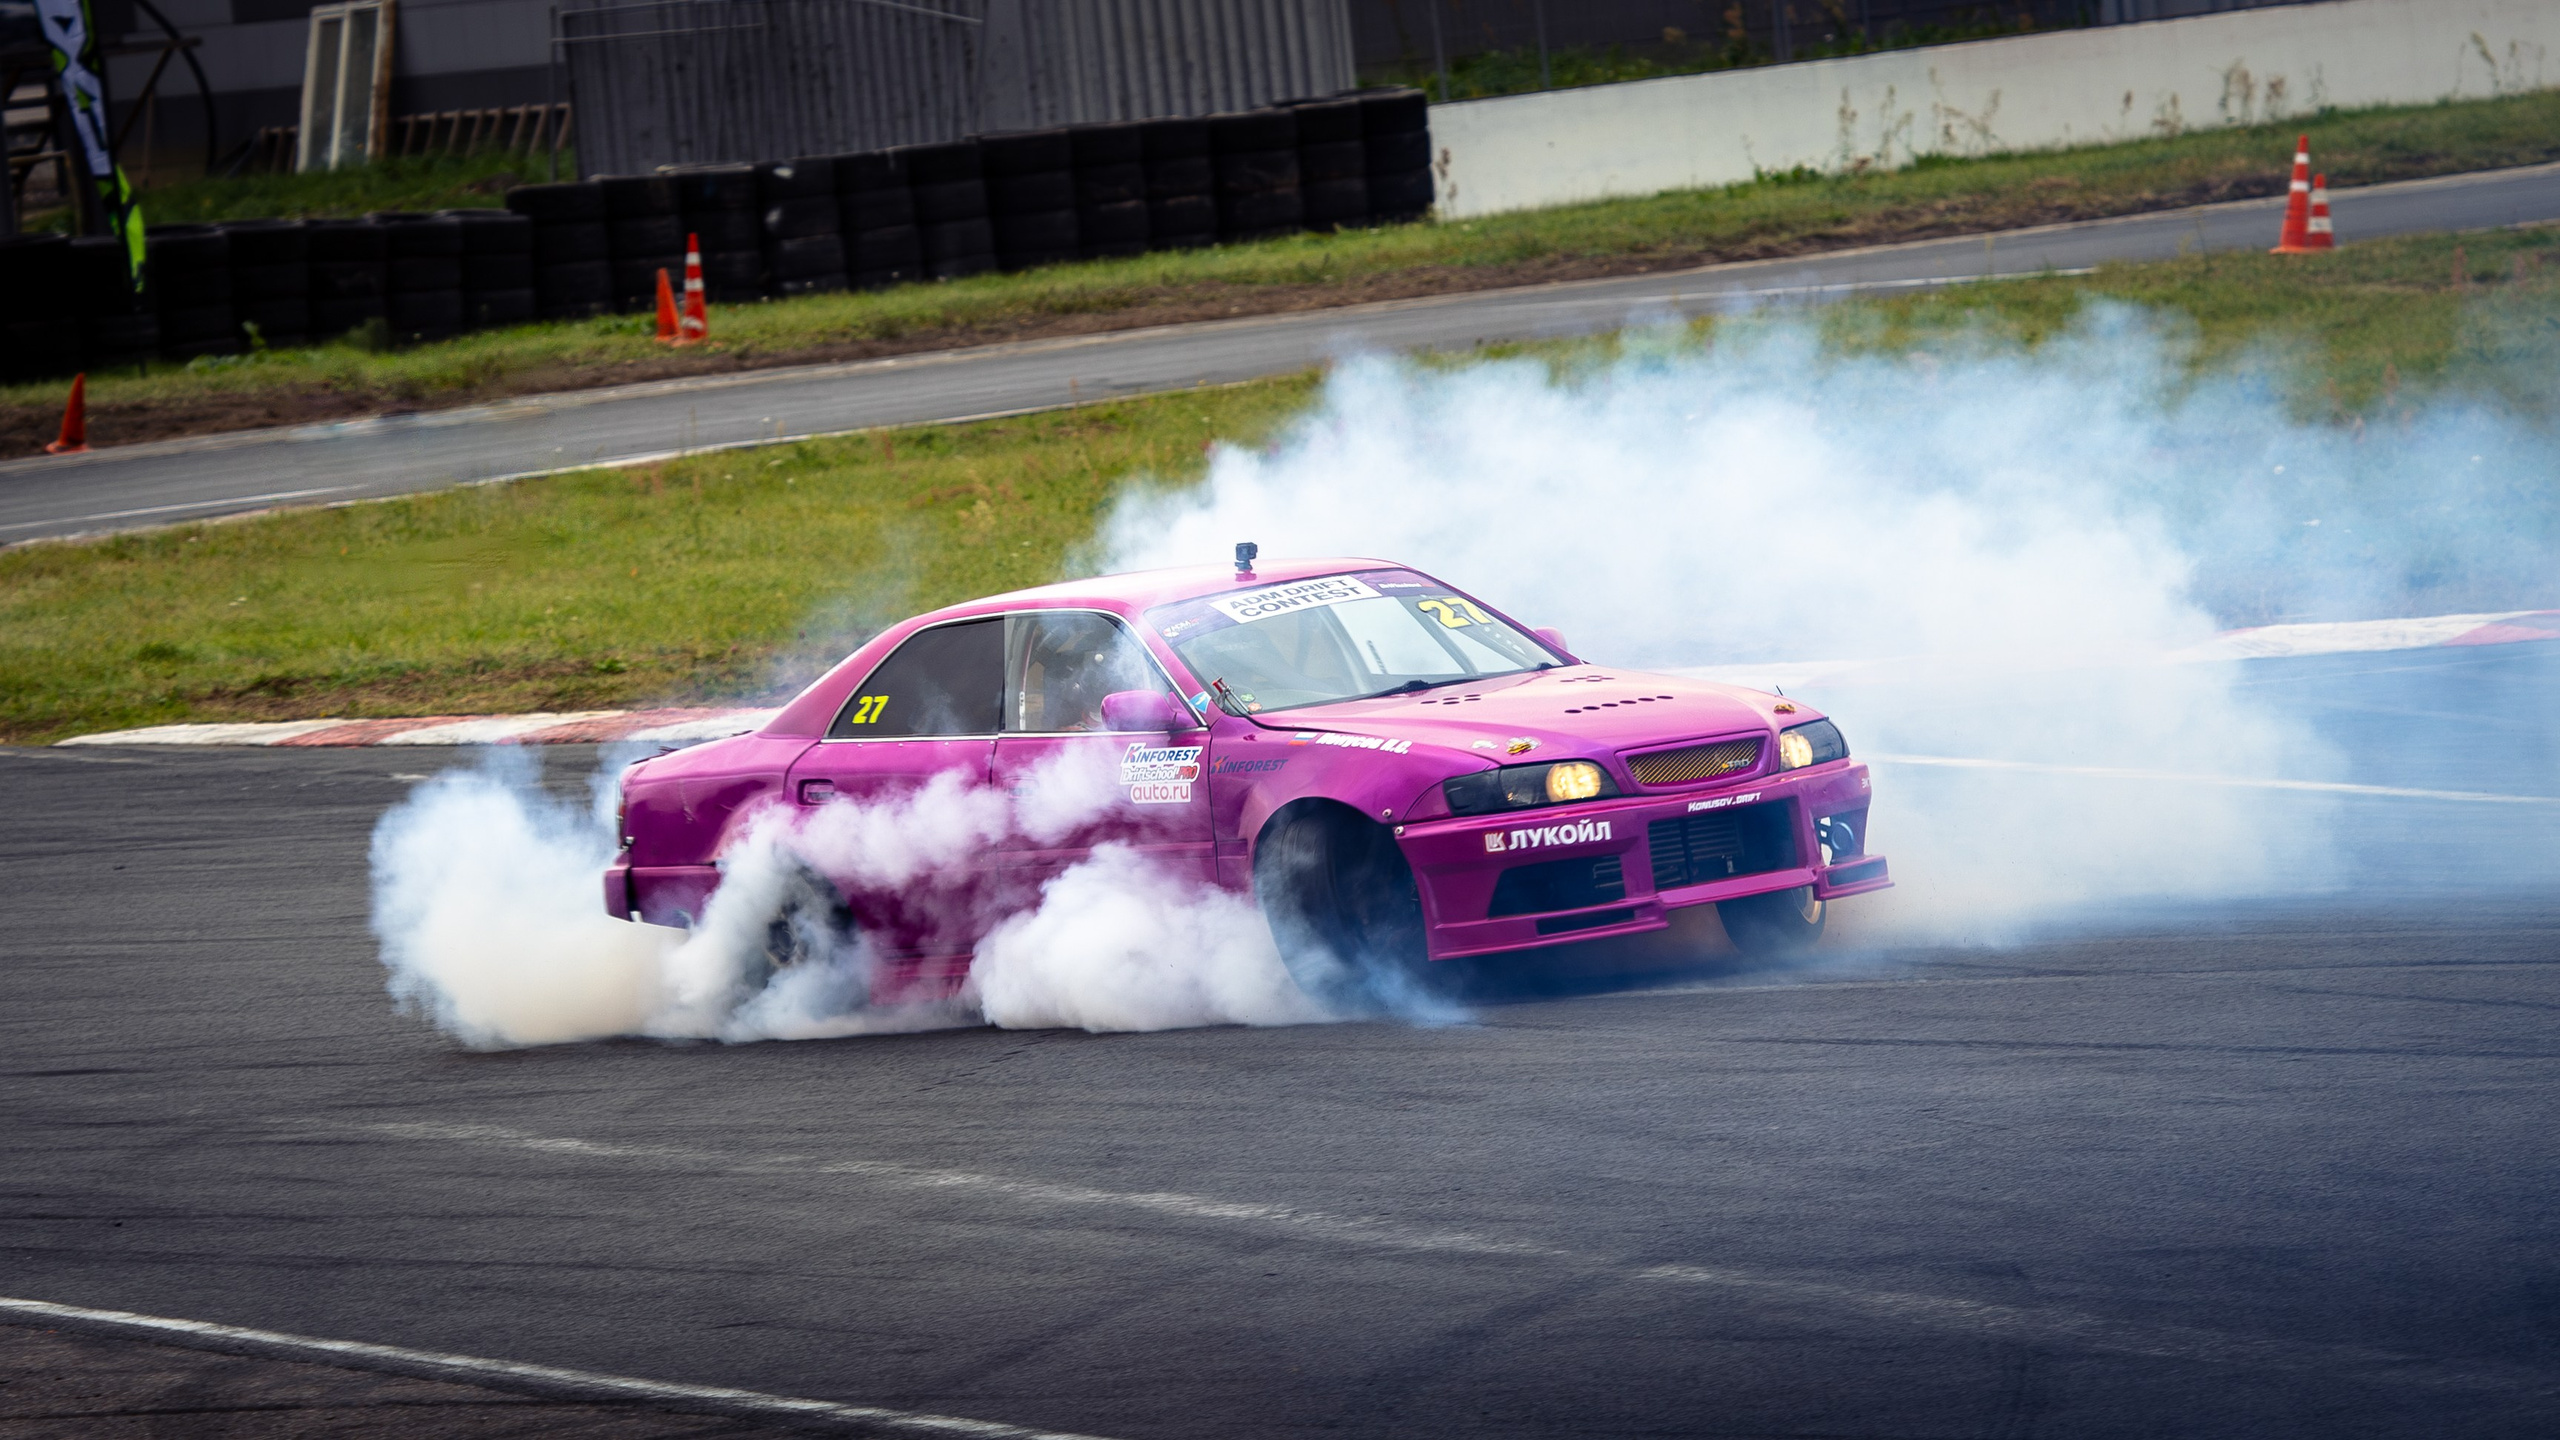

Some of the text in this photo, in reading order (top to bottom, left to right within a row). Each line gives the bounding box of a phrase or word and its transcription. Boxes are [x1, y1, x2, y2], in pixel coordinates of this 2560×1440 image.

[1229, 579, 1348, 609] ADM DRIFT
[1240, 586, 1362, 617] CONTEST
[1418, 597, 1493, 629] 27
[852, 695, 890, 724] 27
[1124, 746, 1200, 764] KINFOREST
[1211, 755, 1288, 774] KINFOREST
[1132, 784, 1190, 800] auto.ru
[1508, 819, 1612, 850] ЛУКОЙЛ
